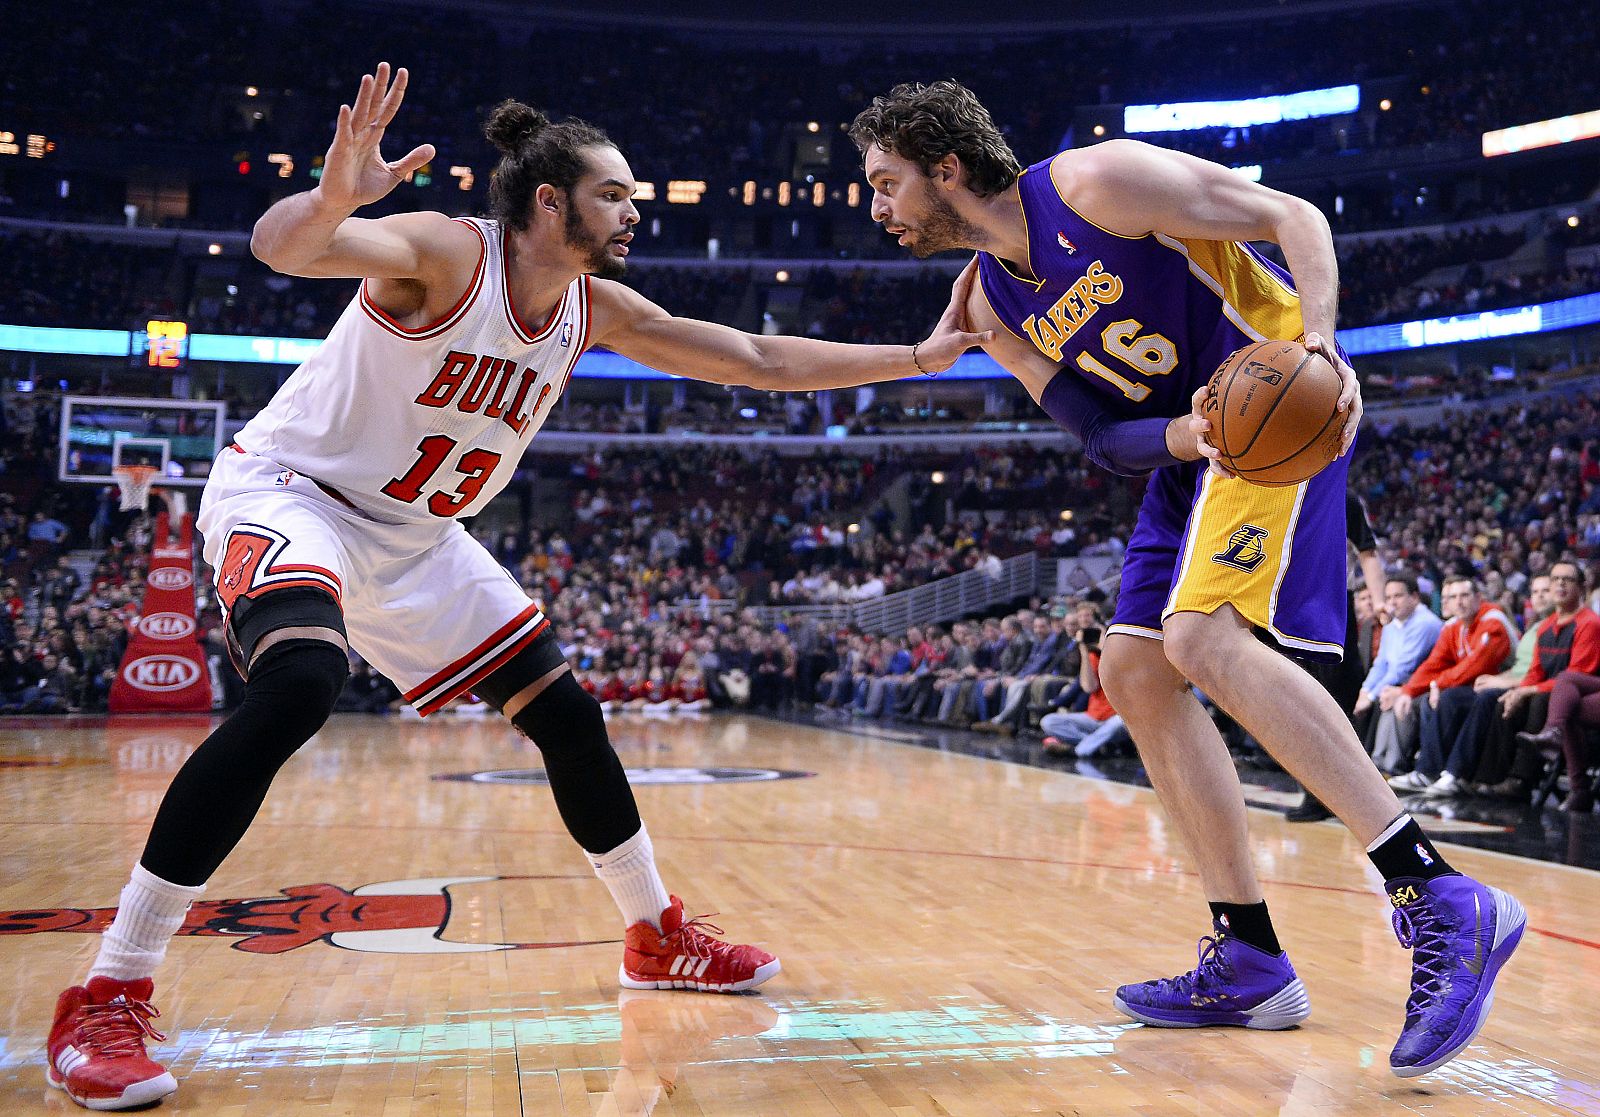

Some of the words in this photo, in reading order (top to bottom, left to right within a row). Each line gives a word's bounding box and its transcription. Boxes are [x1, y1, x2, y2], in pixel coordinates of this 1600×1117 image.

[1021, 260, 1124, 362] LAKERS
[1076, 319, 1179, 403] 16
[380, 434, 502, 518] 13
[155, 572, 184, 584] KIA
[147, 619, 182, 634] KIA
[136, 663, 187, 684] KIA
